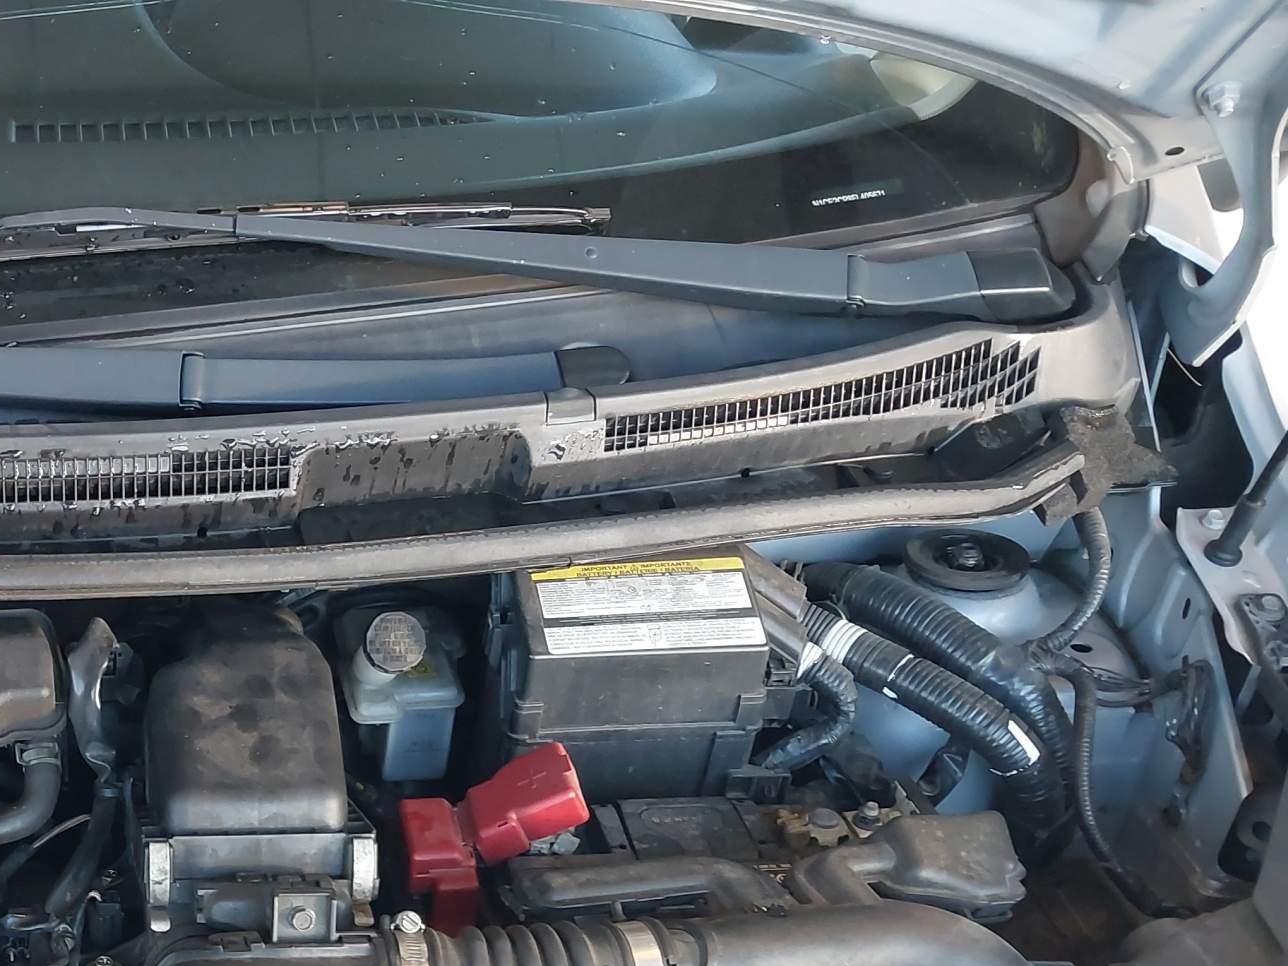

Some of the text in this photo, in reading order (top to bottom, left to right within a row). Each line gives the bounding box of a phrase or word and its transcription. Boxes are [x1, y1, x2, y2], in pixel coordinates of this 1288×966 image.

[640, 561, 691, 569] IMPORTANTE
[619, 567, 658, 575] BATTERIE
[664, 565, 699, 573] BATERIA
